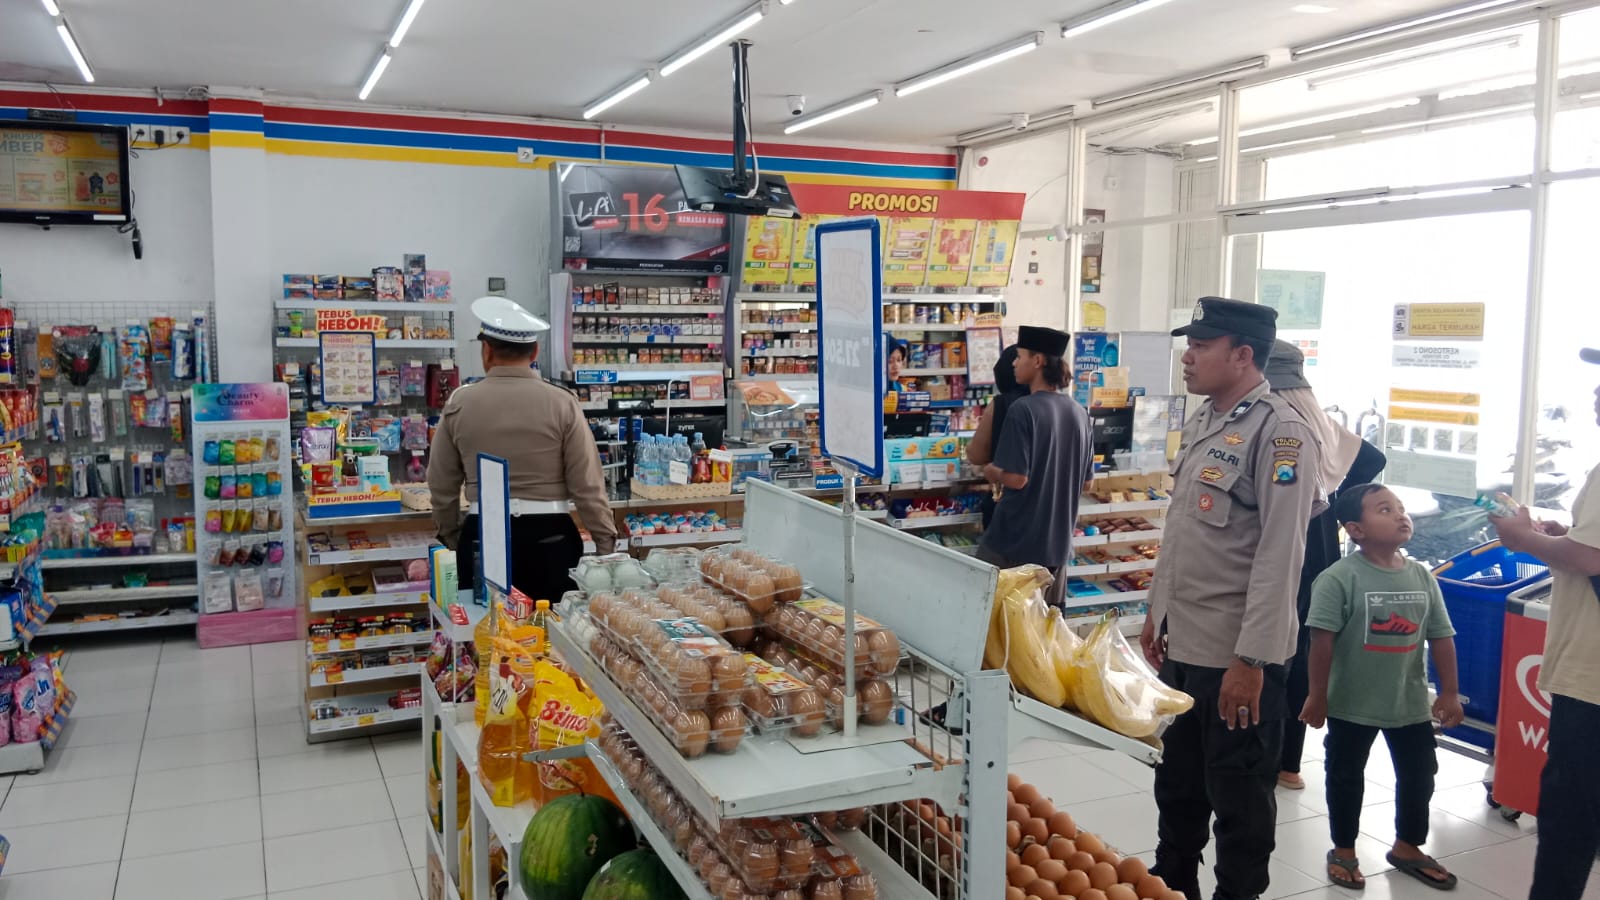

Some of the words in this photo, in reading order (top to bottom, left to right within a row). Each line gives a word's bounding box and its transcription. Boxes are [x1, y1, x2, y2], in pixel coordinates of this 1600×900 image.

[848, 192, 939, 213] PROMOSI
[622, 192, 670, 232] 16
[317, 310, 352, 319] TEBUS
[317, 317, 381, 331] HEBOH!
[1103, 426, 1126, 434] acer
[1207, 448, 1240, 467] POLRI
